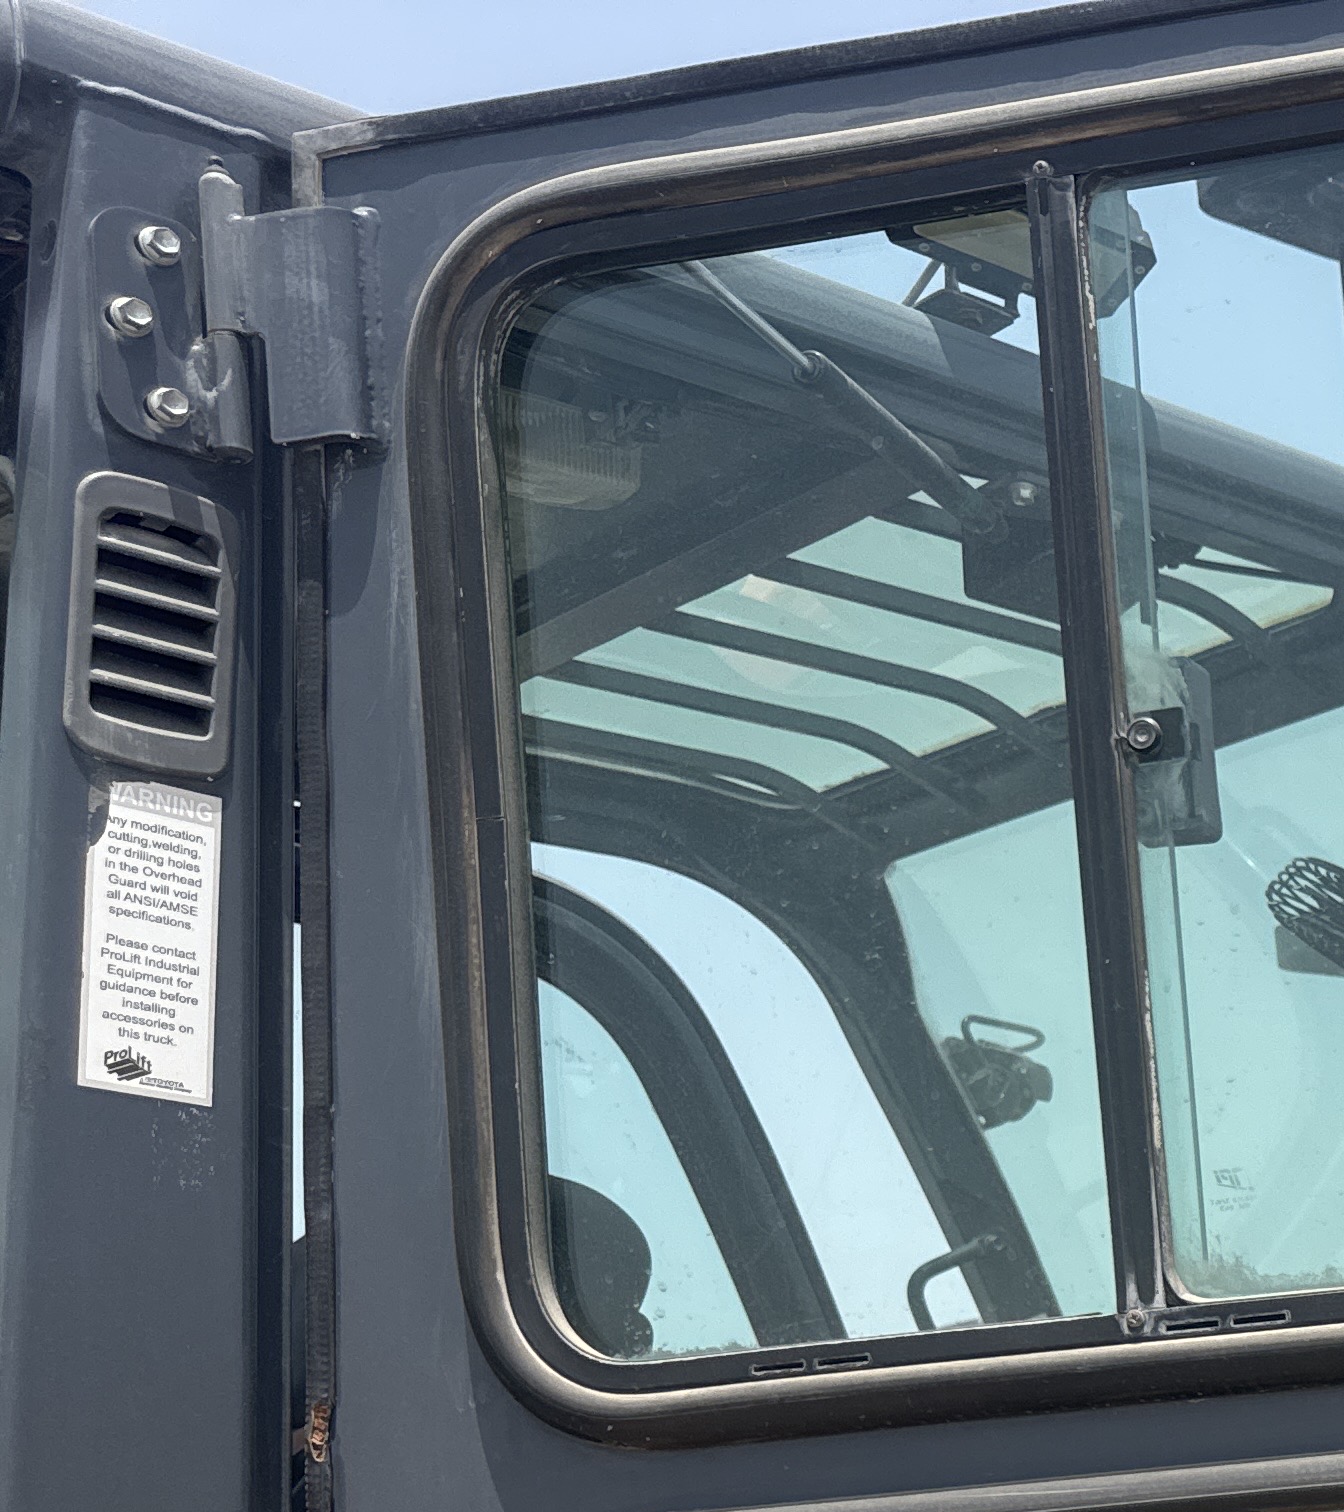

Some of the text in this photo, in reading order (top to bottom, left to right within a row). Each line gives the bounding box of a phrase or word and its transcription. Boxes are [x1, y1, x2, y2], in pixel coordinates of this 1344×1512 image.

[131, 820, 207, 847] modification,
[104, 857, 202, 888] in the Overhead
[107, 845, 200, 873] or drilling holes
[108, 873, 198, 902] Guard will void
[106, 889, 199, 917] all ANSI/AMSE
[108, 905, 196, 932] specifications.
[105, 932, 197, 961] Please contact
[100, 947, 200, 977] ProLift Industrial
[107, 963, 193, 990] Equipment for
[99, 979, 199, 1006] guidance before
[121, 996, 176, 1019] installing
[101, 1010, 195, 1035] accessories on
[118, 1026, 178, 1047] this truck.
